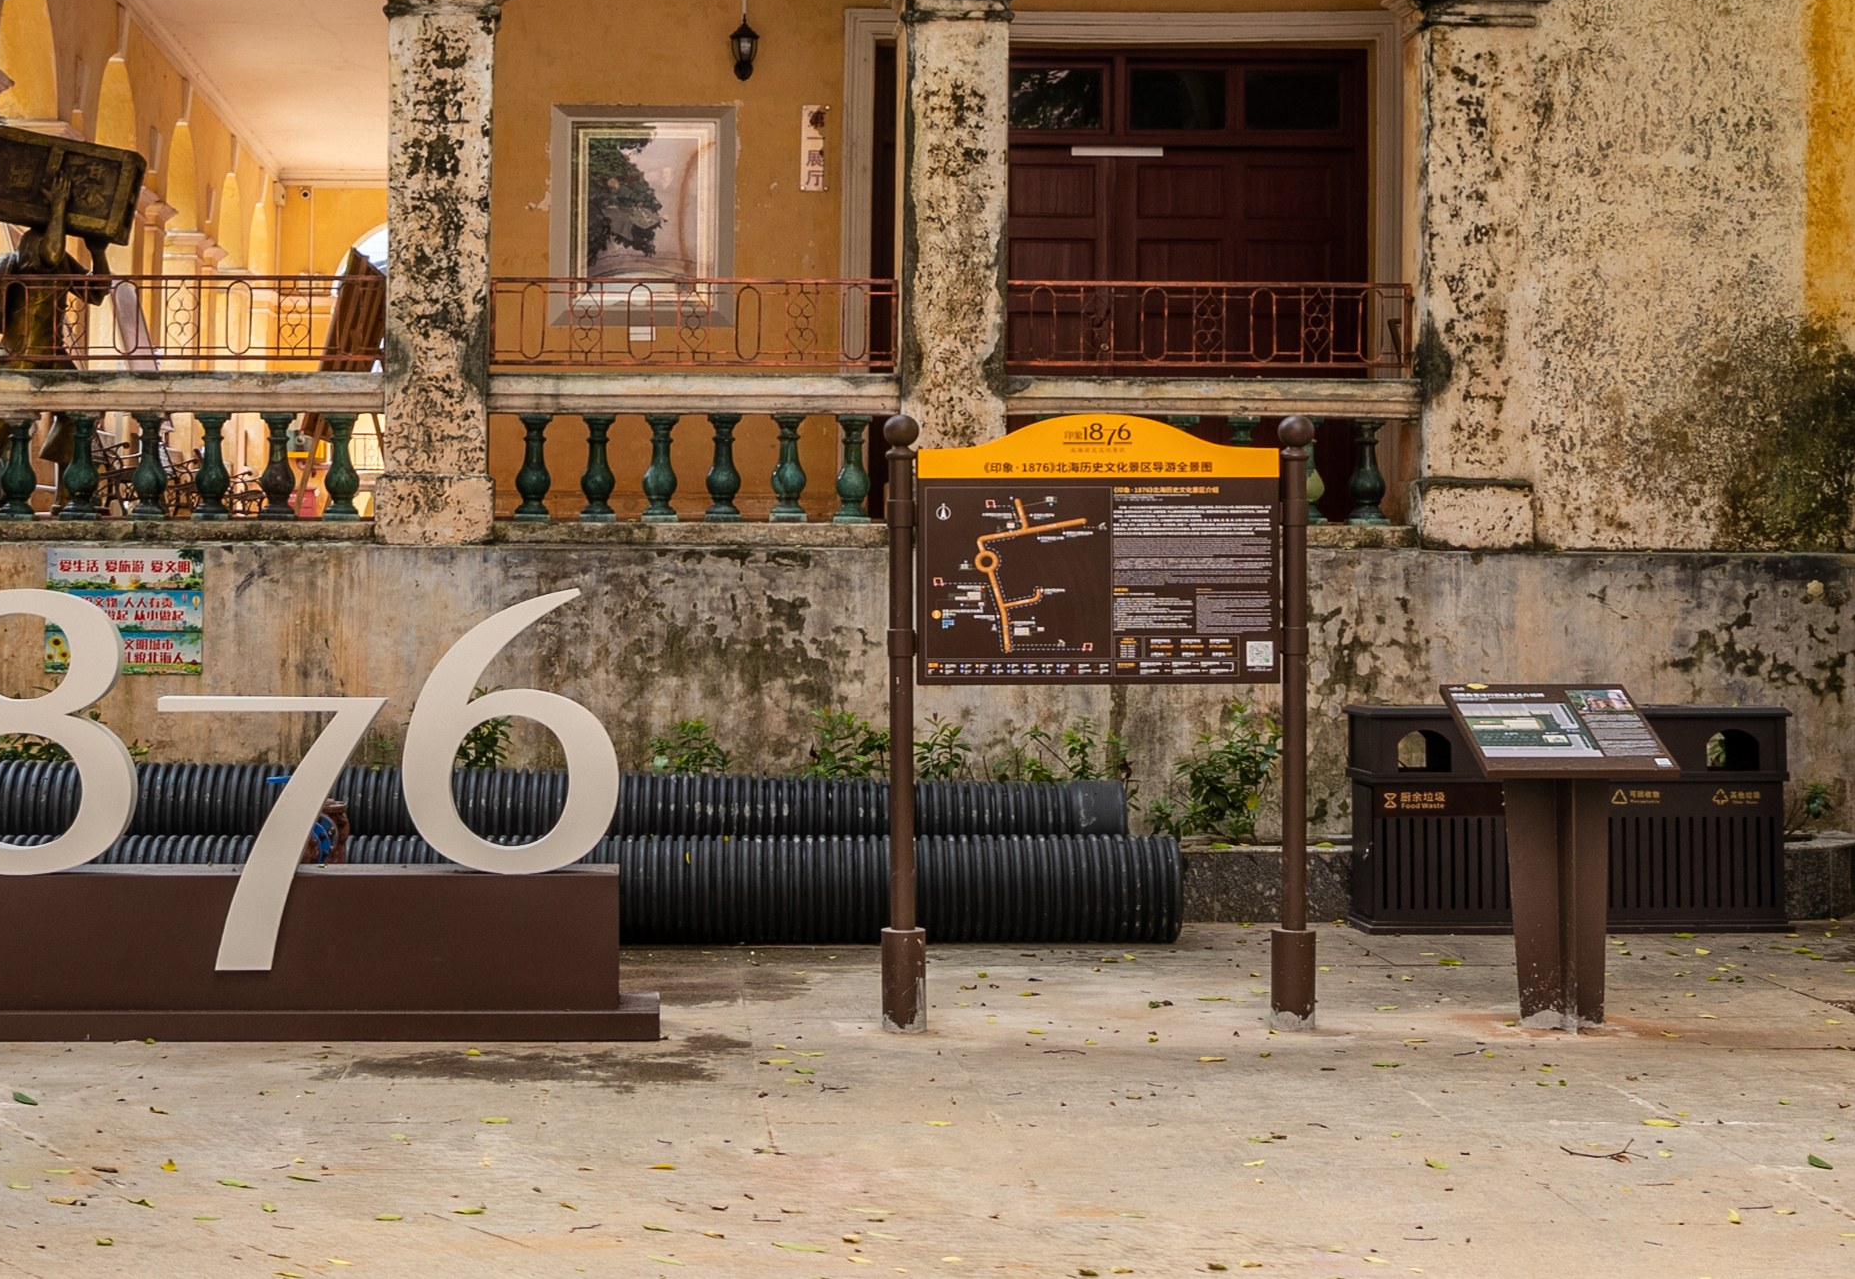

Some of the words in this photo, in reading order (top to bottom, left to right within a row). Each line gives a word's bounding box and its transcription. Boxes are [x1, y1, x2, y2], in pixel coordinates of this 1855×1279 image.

[59, 559, 99, 573] 爱生活
[105, 560, 145, 573] 爱旅游
[151, 560, 191, 574] 爱文明
[124, 597, 173, 608] 人人有责
[134, 609, 184, 621] 从小做起
[125, 638, 174, 650] 文明城市
[1400, 792, 1445, 802] 厨余垃圾
